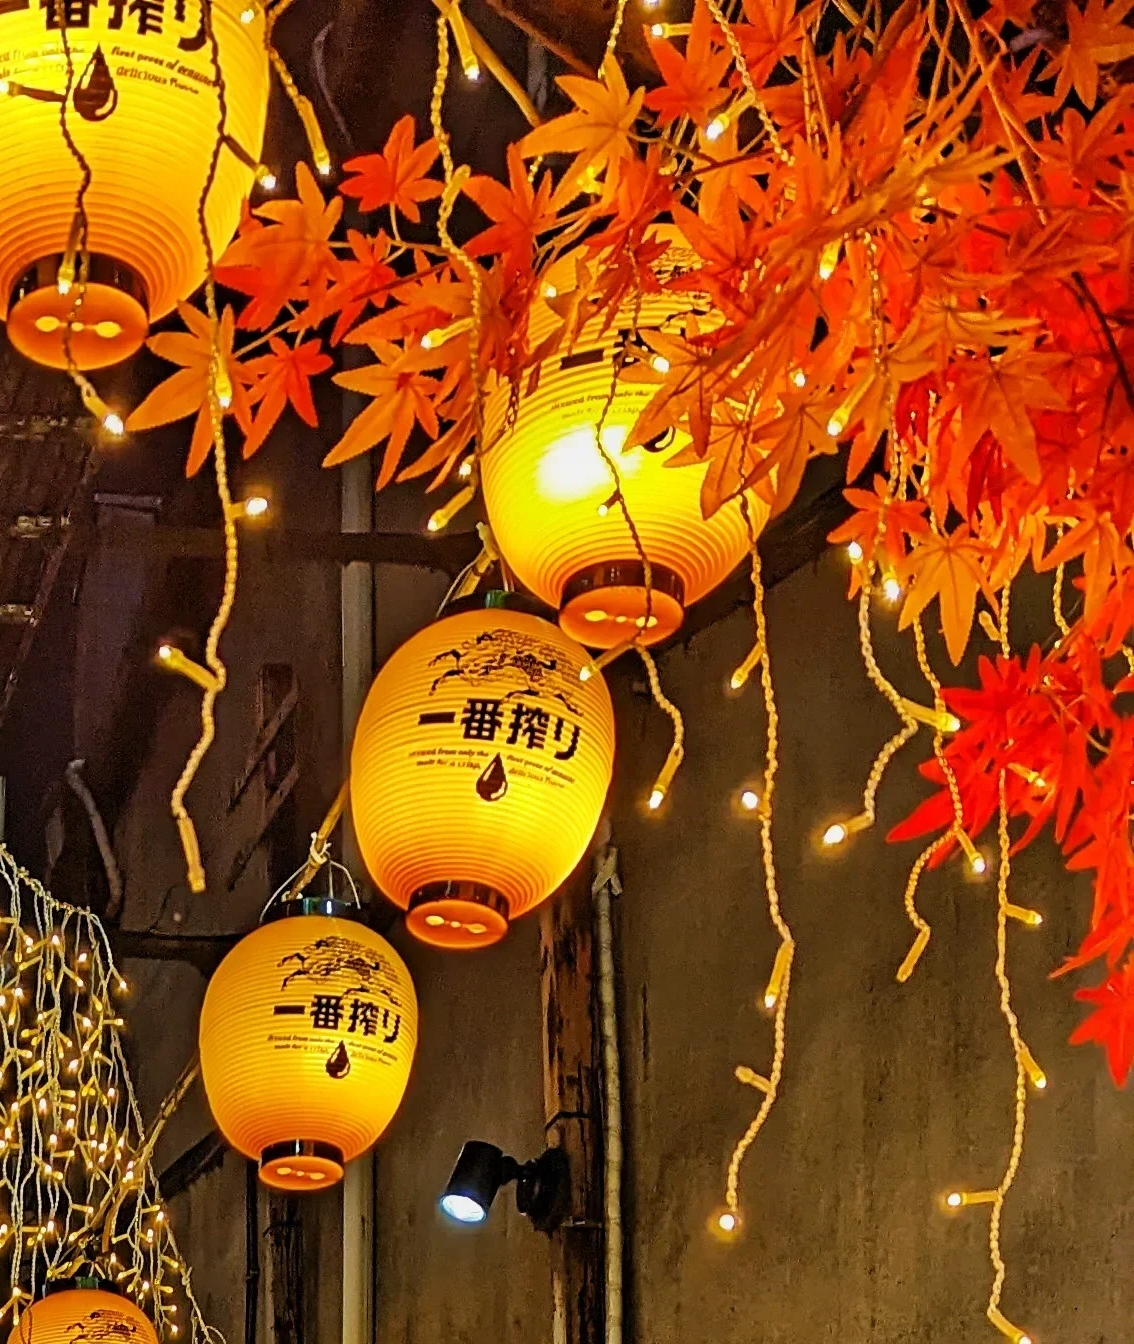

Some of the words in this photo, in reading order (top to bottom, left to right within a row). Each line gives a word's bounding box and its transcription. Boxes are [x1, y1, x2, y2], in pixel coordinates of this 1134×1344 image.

[418, 698, 581, 761] 一番搾り
[273, 994, 401, 1043] 一番搾り
